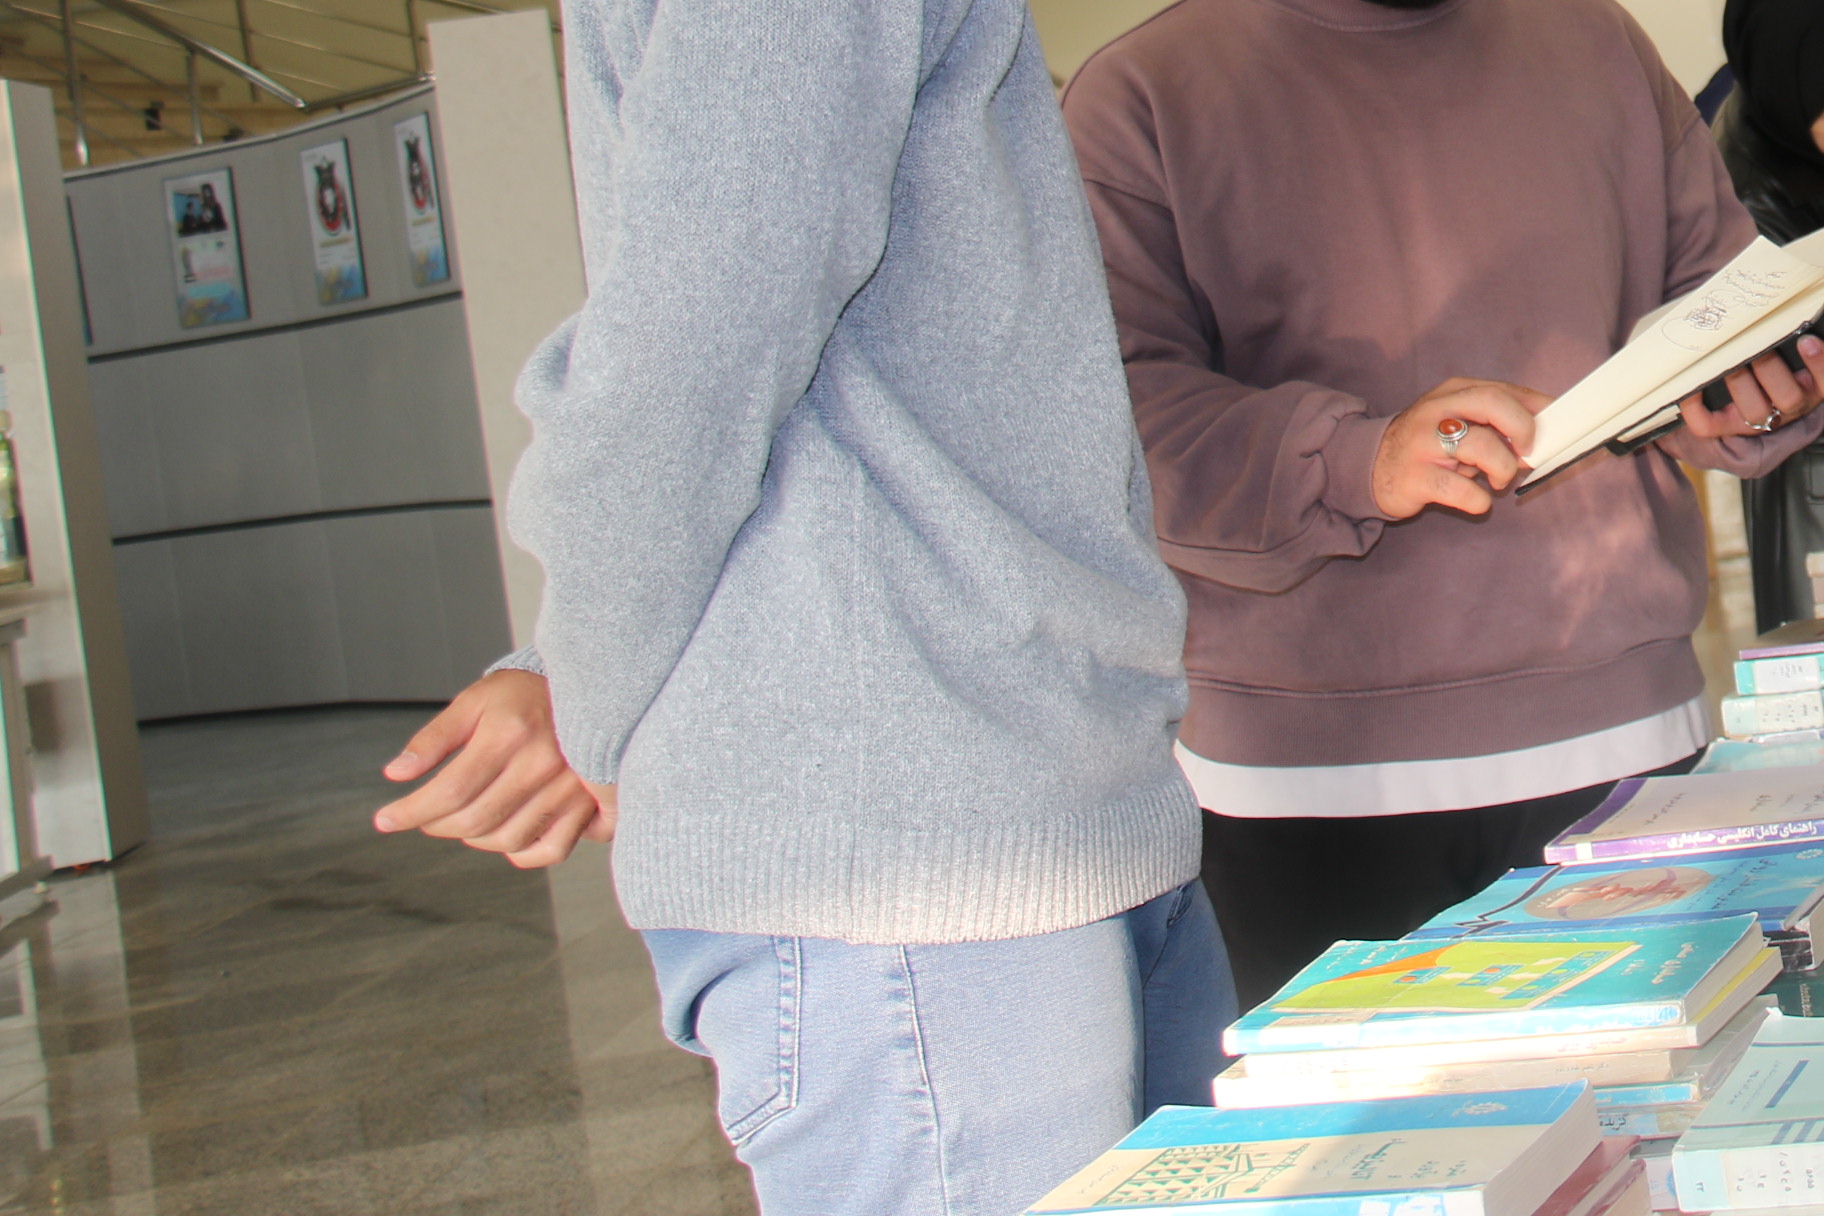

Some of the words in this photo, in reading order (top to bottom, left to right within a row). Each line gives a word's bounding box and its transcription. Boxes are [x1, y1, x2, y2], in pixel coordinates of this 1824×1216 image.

[1717, 825, 1756, 844] انگلیسی
[1758, 823, 1780, 840] کامل
[1779, 821, 1817, 838] راهنمای
[1667, 831, 1716, 849] حسابداری
[1599, 1114, 1628, 1131] گزیده
